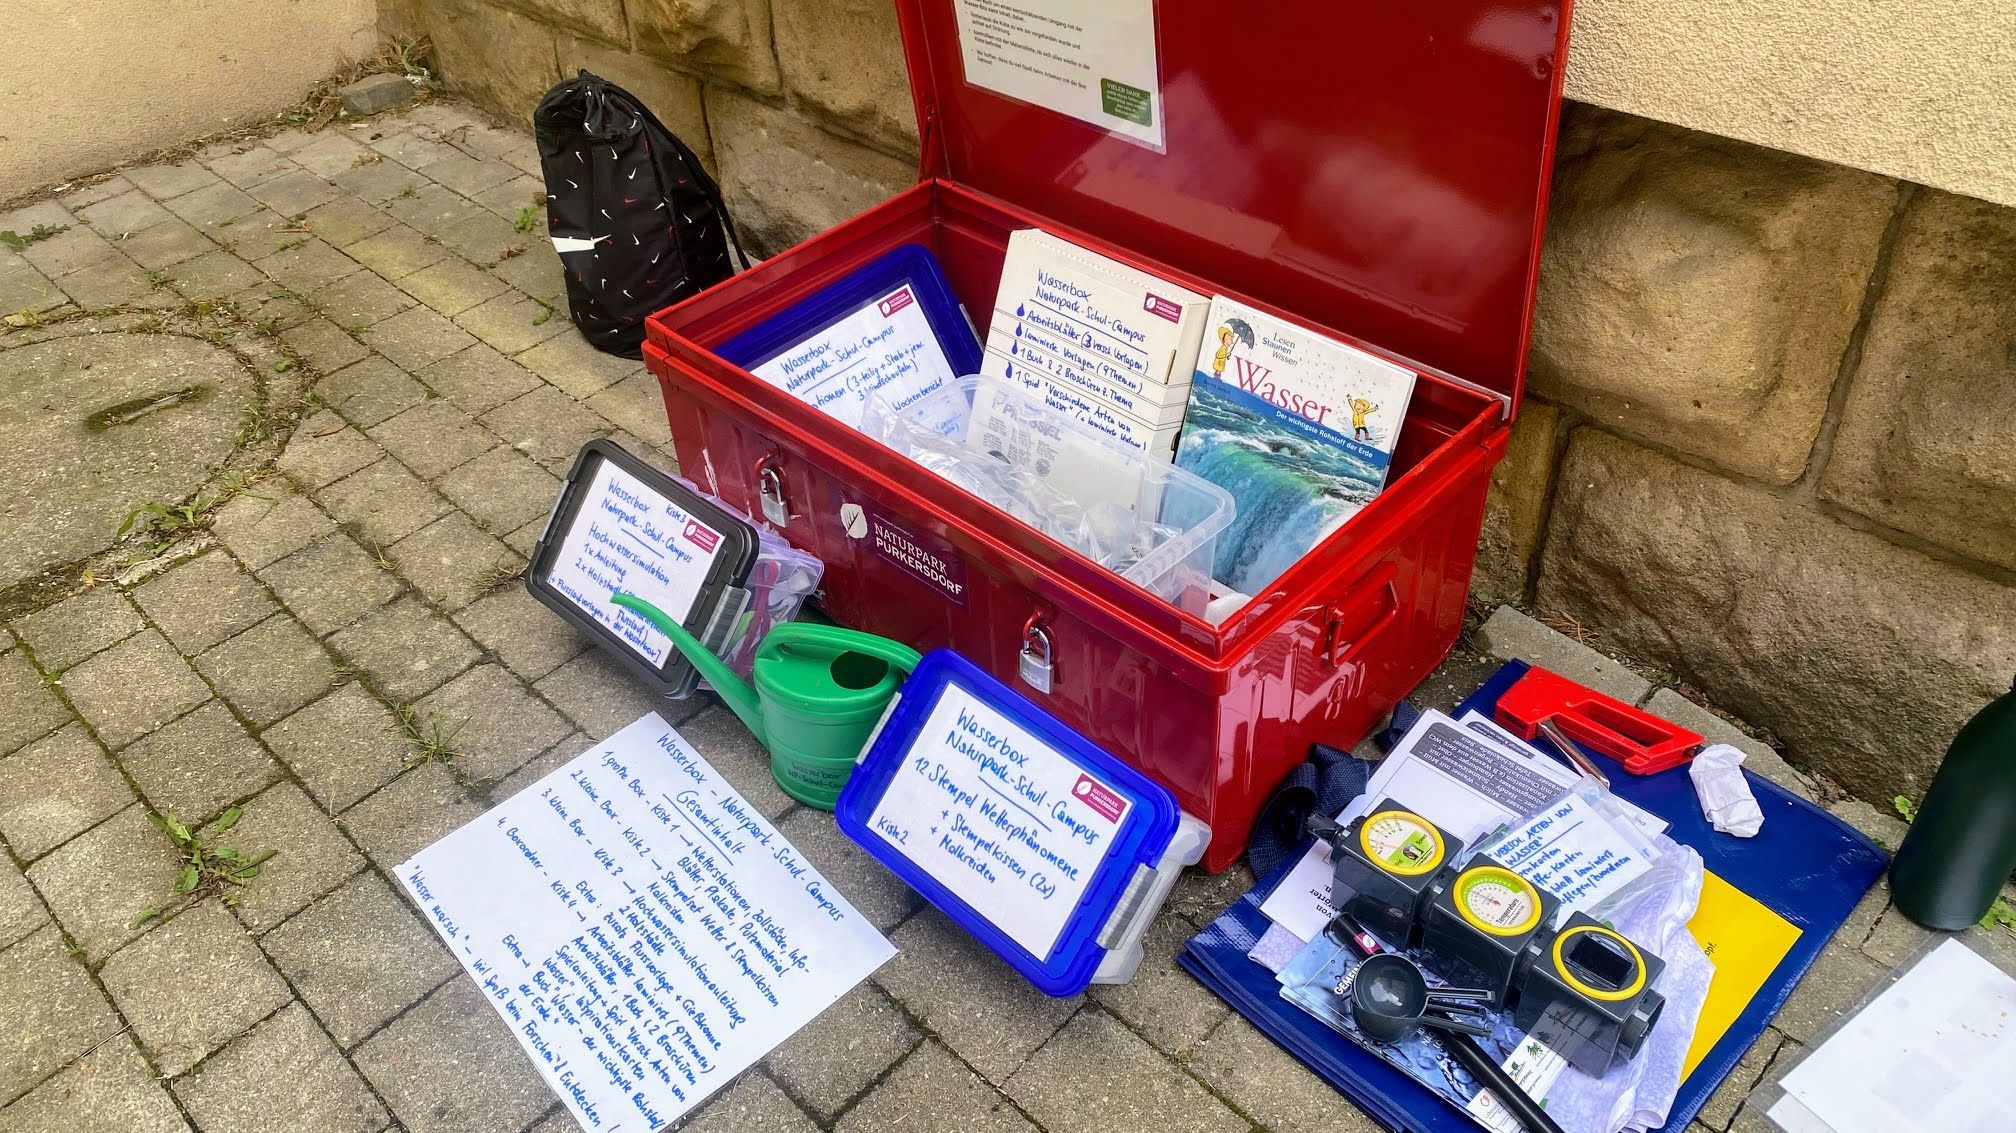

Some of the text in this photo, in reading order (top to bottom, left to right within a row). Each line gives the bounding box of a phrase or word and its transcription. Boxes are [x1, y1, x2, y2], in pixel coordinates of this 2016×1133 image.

[1038, 269, 1092, 302] Wasserbox
[1026, 310, 1081, 340] Arbeitsblätter
[1262, 337, 1292, 355] Staunen
[1273, 332, 1295, 348] Lesen
[780, 342, 831, 375] Wasserbox
[885, 350, 904, 366] Stab
[1024, 328, 1058, 353] laminierte
[1063, 347, 1095, 372] Vorlagen
[1272, 350, 1298, 367] Wissen
[892, 376, 943, 411] Wochenbericht
[1023, 372, 1040, 388] Spiel
[1094, 406, 1115, 425] Arten
[1118, 421, 1131, 433] von
[1026, 350, 1133, 410] Buch Broschüren Thema
[1234, 355, 1332, 425] Wasser
[1276, 411, 1373, 458] Der wichtigste Rohstoff der Erde
[608, 477, 651, 514] Wasserbox
[666, 504, 681, 521] Kiste
[588, 521, 670, 586] Hochwassersimulation
[593, 550, 627, 583] Anleitung
[874, 523, 947, 576] NATURPARK
[876, 537, 962, 594] PURKERSDORF
[613, 621, 624, 632] der
[656, 732, 707, 784] Wasserbox
[957, 707, 1029, 768] Wasserbox
[1443, 741, 1457, 750] dem
[1457, 749, 1469, 757] aus
[1462, 737, 1531, 777] Tafel Schokolade Reis
[1423, 753, 1500, 798] Milch Wasser mit Müll
[1429, 749, 1518, 800] Handy Schmelzwasser mit
[1453, 740, 1553, 794] mit Chemikalien Regenwasser
[1458, 757, 1494, 779] Hamburger
[1469, 756, 1492, 770] Wasser
[628, 779, 646, 798] Box
[650, 803, 670, 825] Kiste
[1506, 775, 1547, 799] Kanalisation
[548, 796, 568, 820] kleine
[569, 818, 586, 837] Box
[593, 848, 615, 870] Kiste
[676, 790, 746, 854] Gesamtinhalt
[877, 816, 899, 839] Kiste
[915, 757, 929, 775] 12
[928, 764, 978, 809] Stempel
[979, 798, 1078, 881] Wetterphänomene
[1526, 817, 1553, 840] ARTEN
[1555, 803, 1573, 818] VON
[939, 834, 995, 883] Malkreiden
[951, 813, 1056, 900] Stempelkissen (2x)
[1574, 849, 1614, 877] laminiert
[578, 777, 779, 1007] kleine Box Kiste Stempelset Wetter Stempelkissen
[1316, 904, 1332, 918] von
[1496, 898, 1520, 924] Temperature
[506, 827, 543, 868] Boxordner
[550, 880, 571, 903] Kiste
[586, 926, 636, 978] Arbeitsblätter
[633, 977, 670, 1020] laminiert
[626, 912, 665, 956] Holzstädte
[677, 856, 705, 891] Blätter,
[739, 922, 794, 978] Putzmaterial
[518, 984, 535, 997] der
[617, 940, 674, 994] Flussvorlage
[682, 999, 721, 1051] Gießkanne
[502, 934, 522, 959] Extra
[533, 971, 551, 994] Buch
[582, 1036, 597, 1051] der
[597, 1051, 632, 1093] wichtigste
[483, 974, 509, 1000] Spaß
[506, 999, 521, 1022] beim
[560, 1071, 601, 1127] Entdecken
[566, 996, 657, 1081] Inspirationskarten
[606, 1005, 628, 1026] Spiel
[649, 1059, 671, 1085] Arten
[671, 1084, 685, 1102] von
[625, 998, 706, 1086] Buch Broschüren
